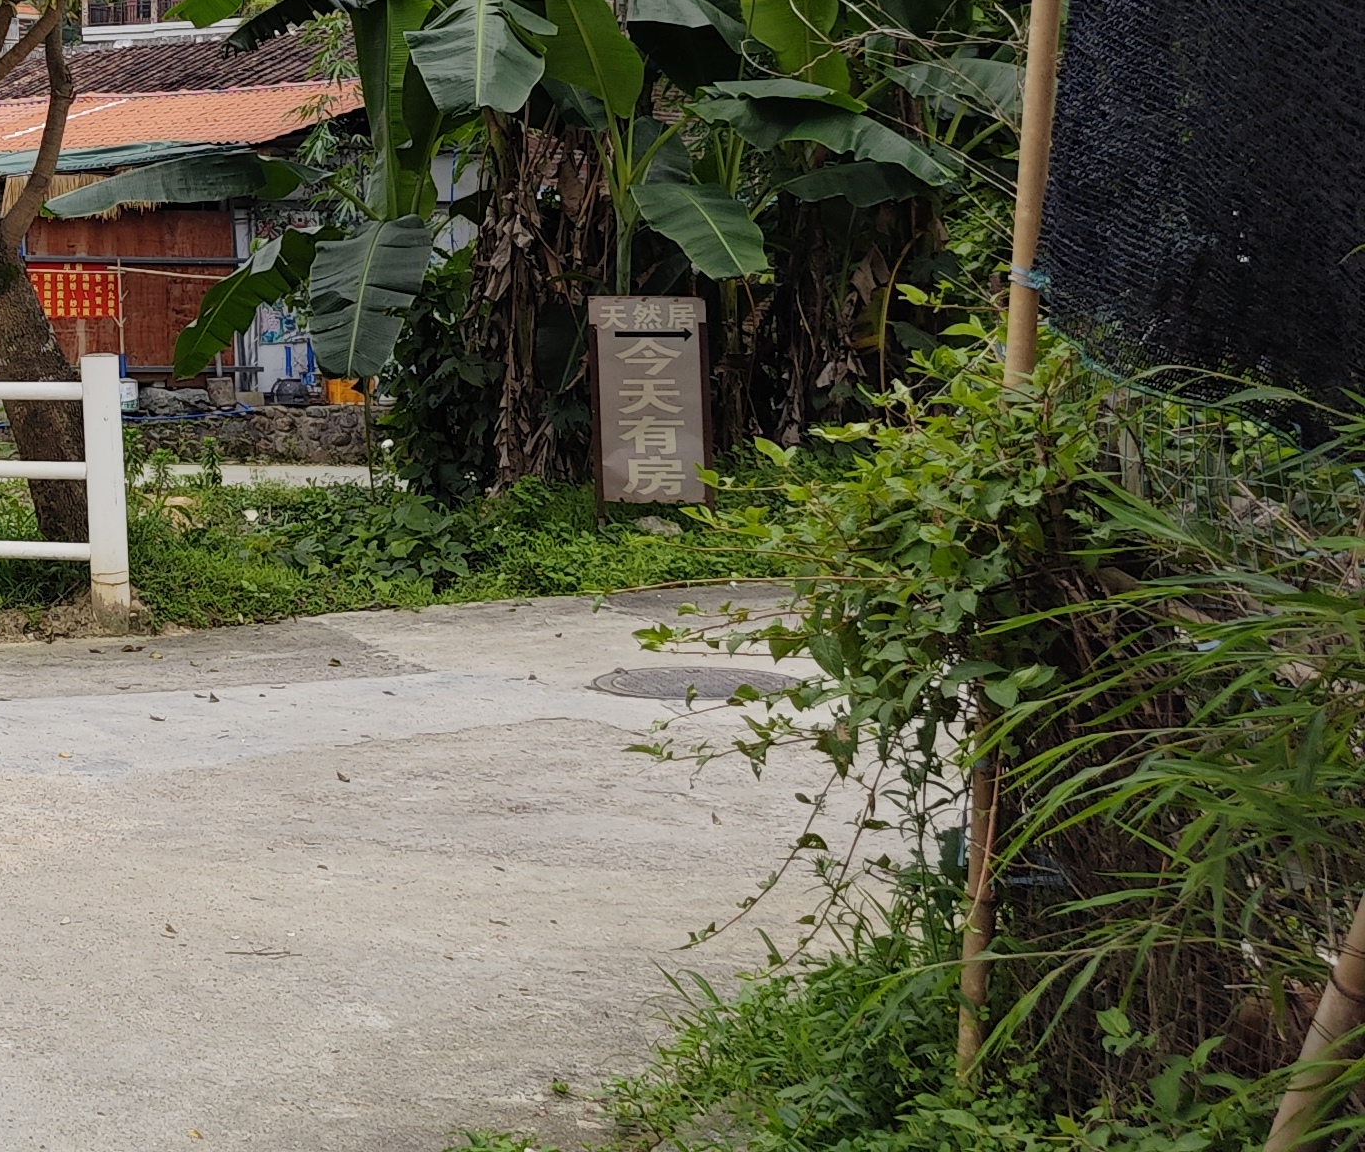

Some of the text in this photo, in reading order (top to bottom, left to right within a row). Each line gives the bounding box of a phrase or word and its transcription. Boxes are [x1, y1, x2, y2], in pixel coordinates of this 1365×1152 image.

[599, 303, 697, 331] 天然居
[614, 338, 687, 496] 今天有房
